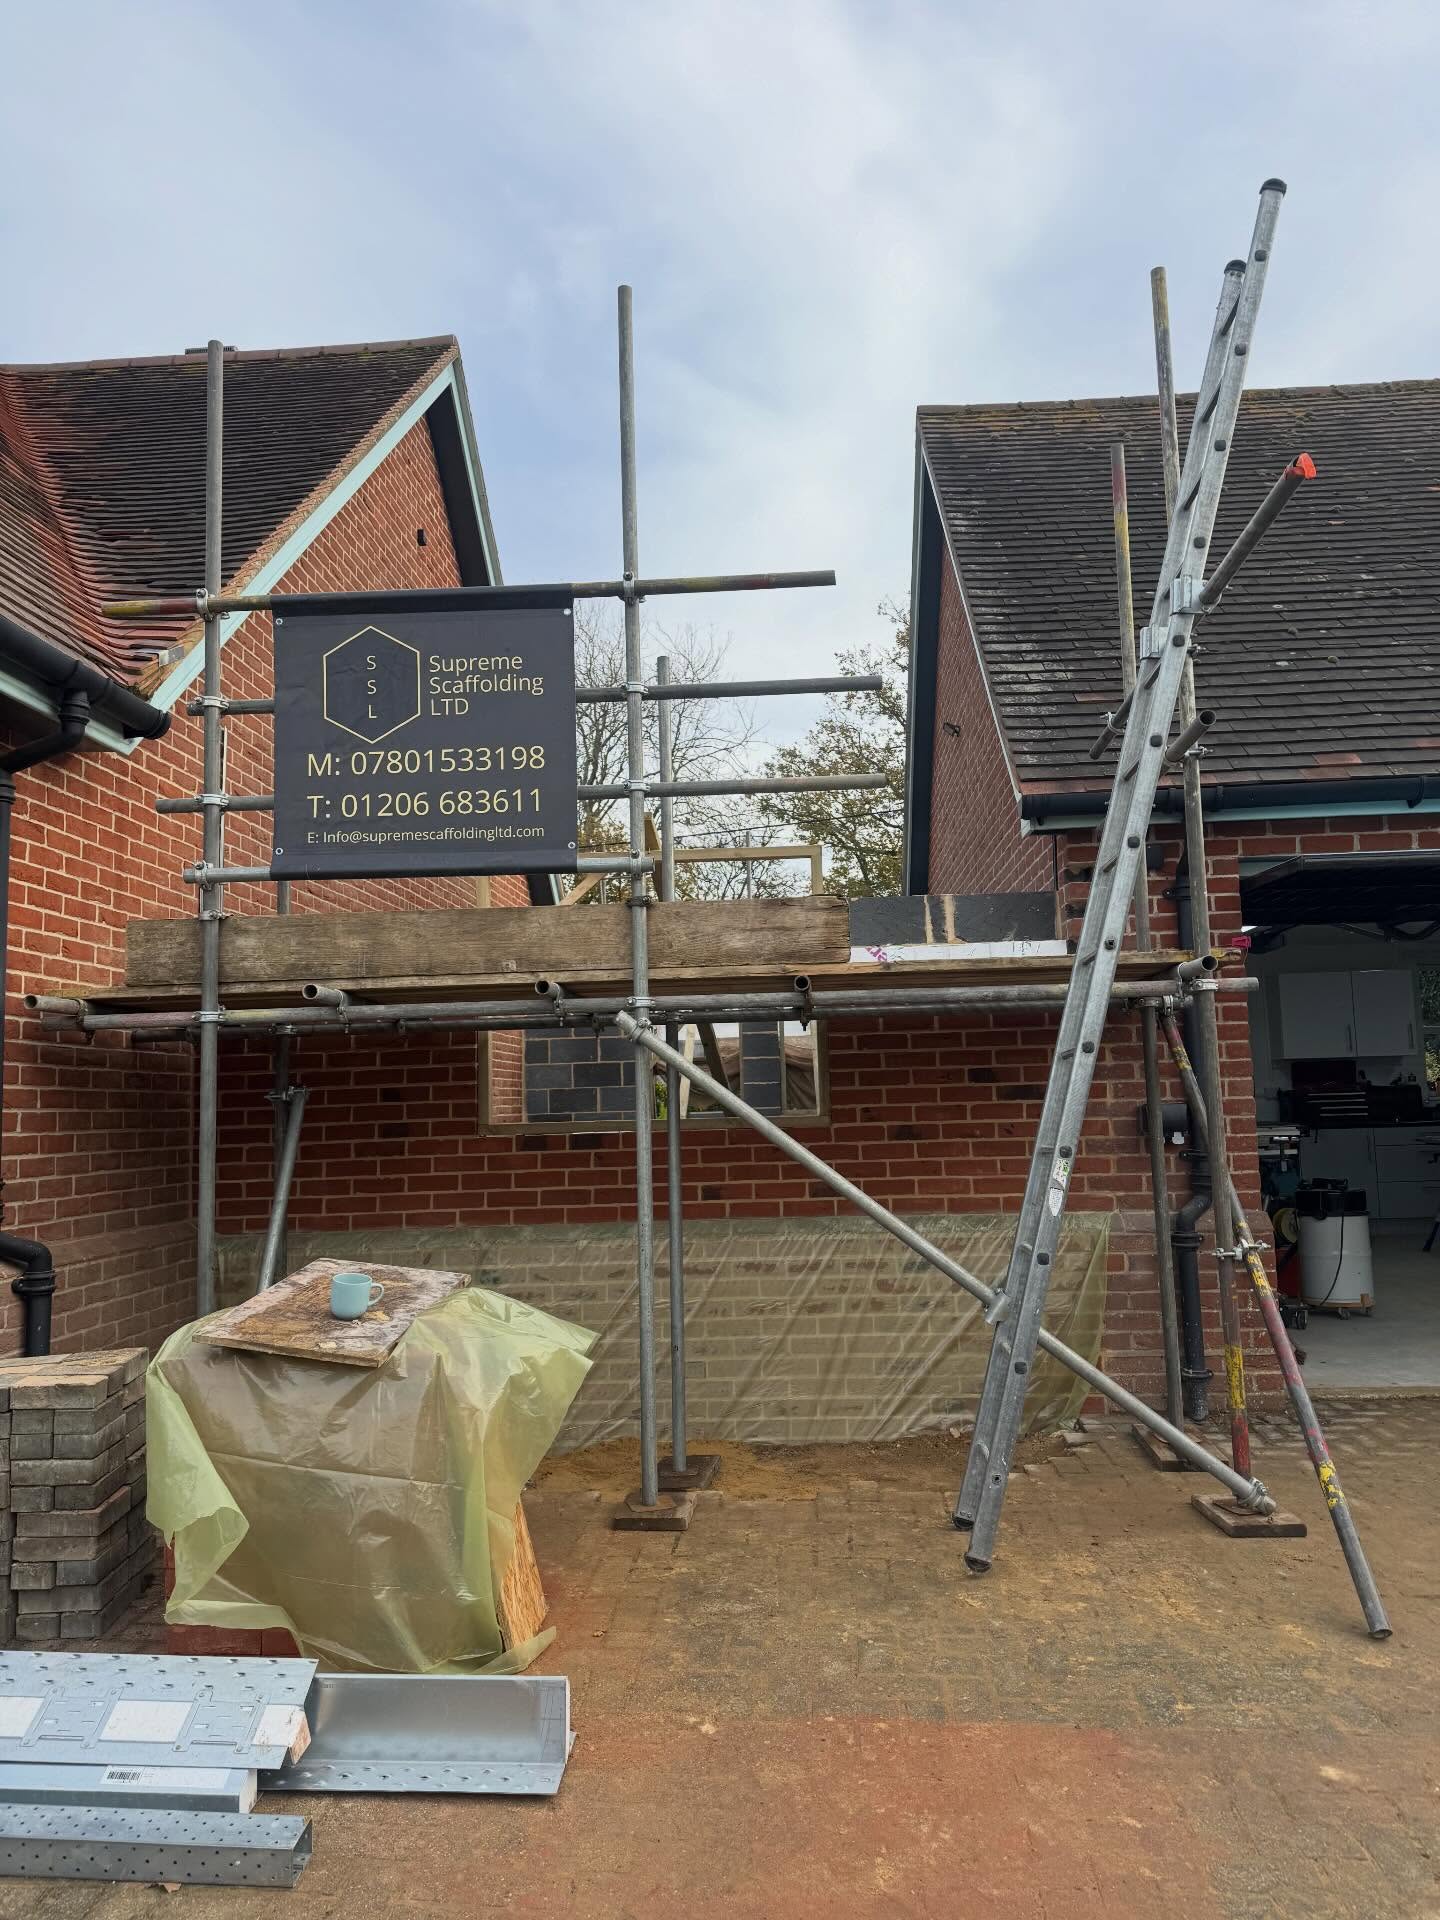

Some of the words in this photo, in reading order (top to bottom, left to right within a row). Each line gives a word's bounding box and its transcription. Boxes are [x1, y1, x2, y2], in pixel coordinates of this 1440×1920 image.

[429, 655, 523, 676] Supreme
[429, 673, 544, 695] Scaffolding
[430, 698, 469, 716] LTD
[307, 752, 341, 777] M:
[351, 746, 546, 775] 07801533198
[306, 795, 331, 818] T:
[341, 792, 430, 818] 01206
[439, 788, 541, 815] 683611
[307, 832, 319, 844] E:
[323, 825, 545, 844] Info@supremescaffoldingltd.com
